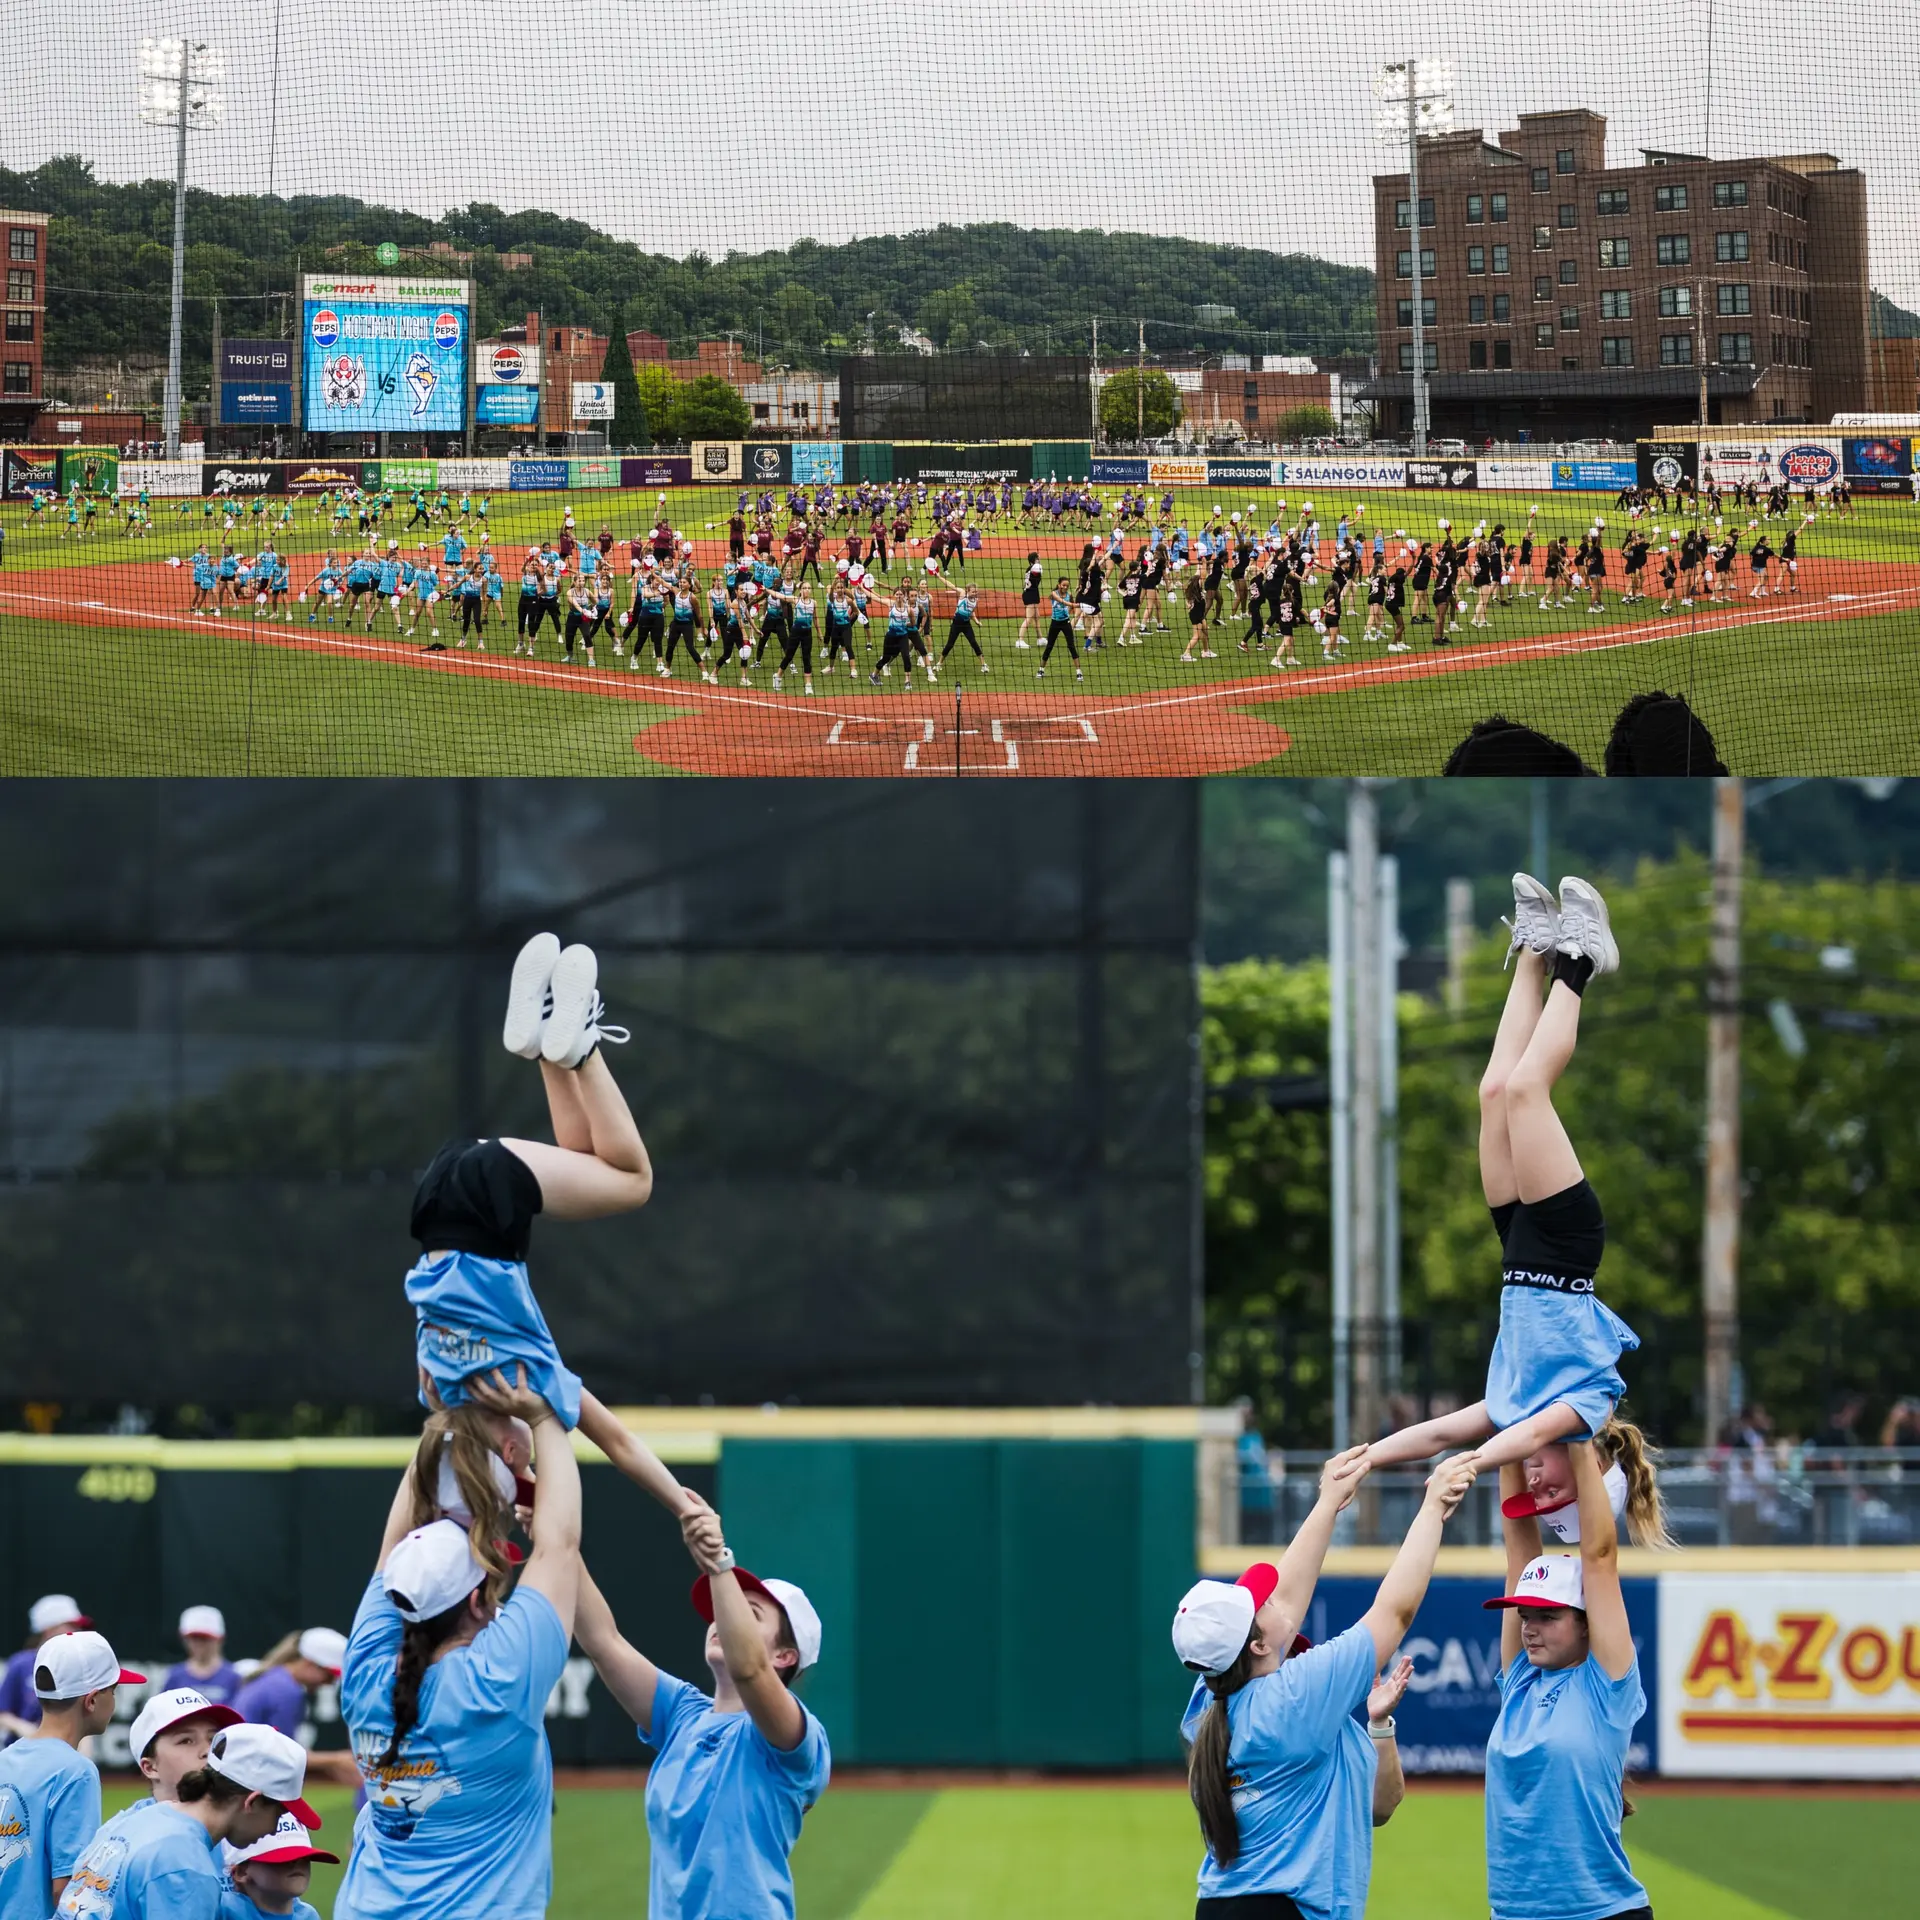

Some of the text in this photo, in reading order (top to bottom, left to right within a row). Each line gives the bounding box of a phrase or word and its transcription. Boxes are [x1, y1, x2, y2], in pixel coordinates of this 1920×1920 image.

[312, 283, 461, 296] gomart BALLPARK
[313, 324, 338, 333] PEPSI
[342, 315, 431, 340] MOTHMAN NIGHT
[435, 326, 458, 335] PEPSI
[228, 355, 270, 365] TRUIST
[493, 360, 522, 368] PEPSI
[378, 373, 396, 394] VS
[1648, 444, 1685, 453] Dirty Birds
[1786, 452, 1831, 468] Jersey
[511, 463, 566, 474] GLENVILLE
[1170, 465, 1205, 474] OUTLET
[1217, 468, 1270, 478] FERGUSON
[1409, 463, 1442, 474] Mister
[1504, 465, 1537, 473] Gallagher
[10, 470, 53, 480] Element
[1295, 468, 1404, 480] SALANGO LAW
[1414, 474, 1435, 484] Bee
[1514, 1270, 1565, 1287] NIKE
[175, 1696, 202, 1705] USA
